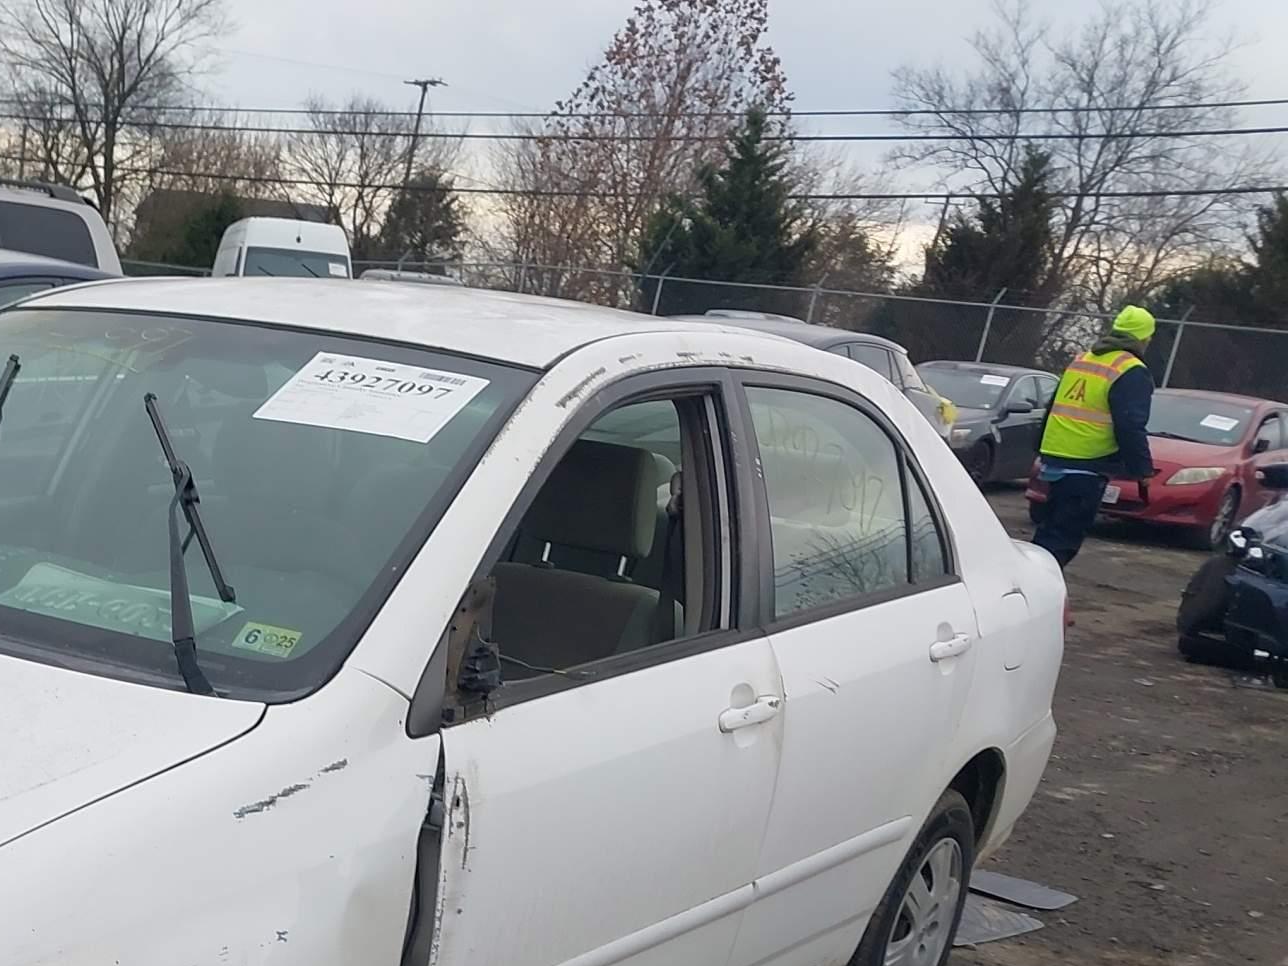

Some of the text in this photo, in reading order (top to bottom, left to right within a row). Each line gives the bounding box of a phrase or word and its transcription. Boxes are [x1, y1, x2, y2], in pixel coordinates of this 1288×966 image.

[314, 369, 453, 399] 43927097
[245, 628, 297, 649] 6 25
